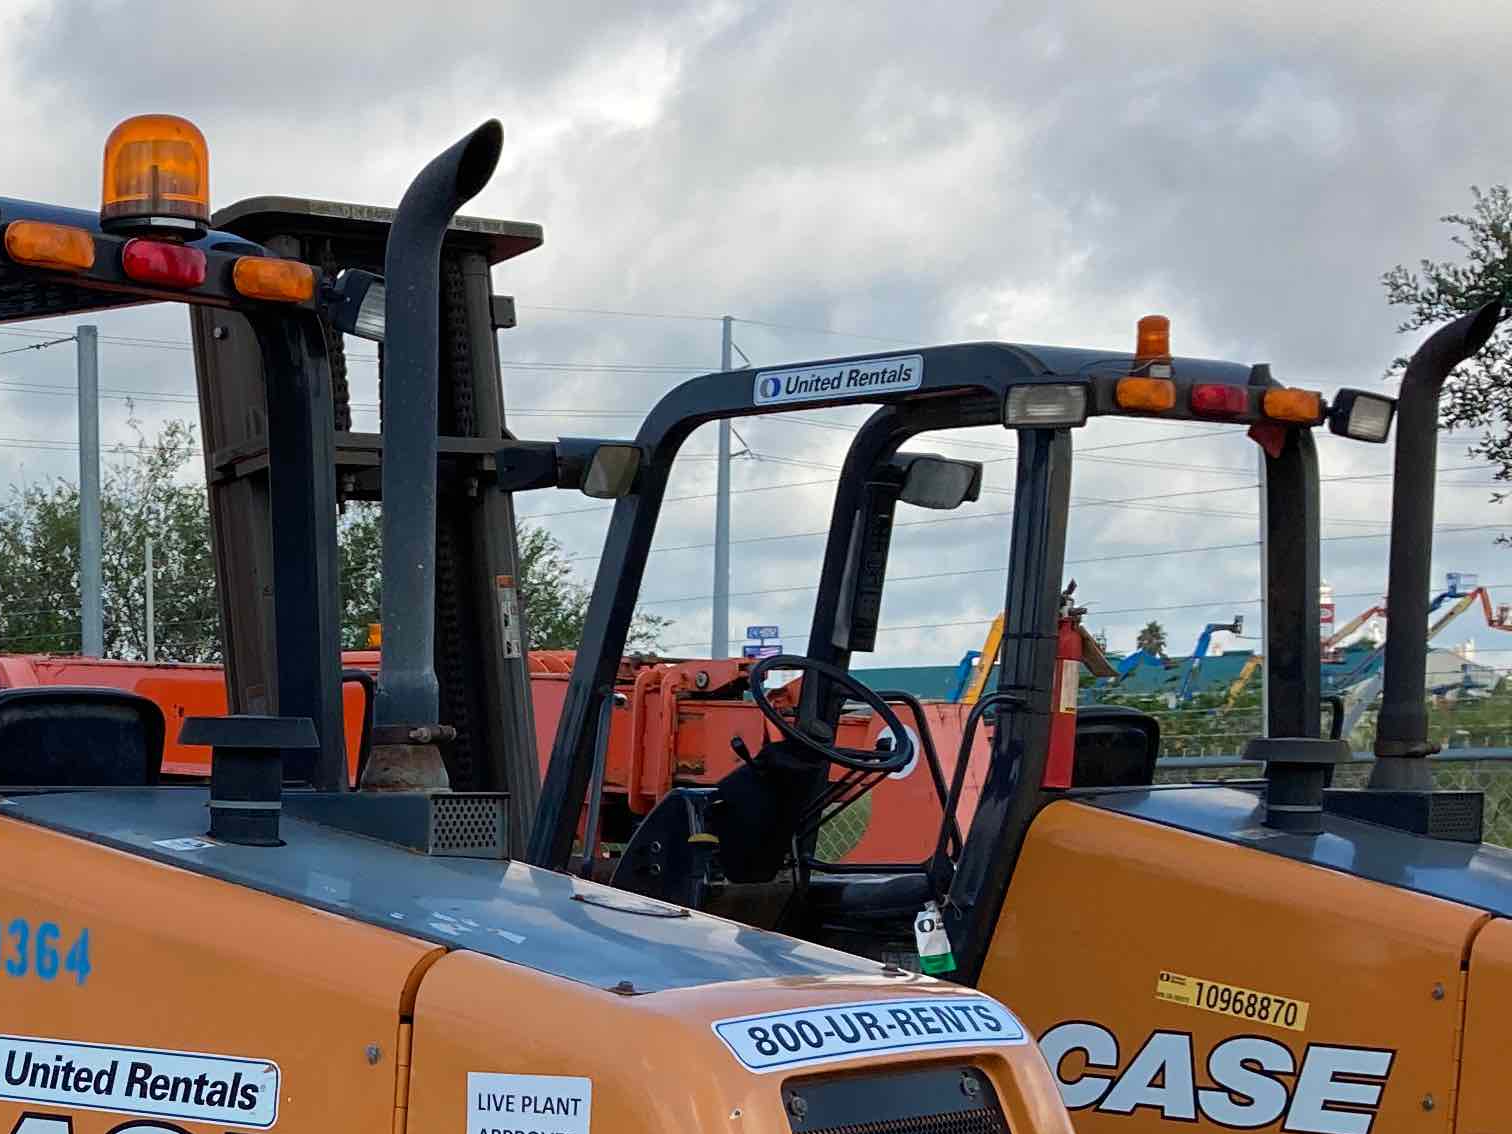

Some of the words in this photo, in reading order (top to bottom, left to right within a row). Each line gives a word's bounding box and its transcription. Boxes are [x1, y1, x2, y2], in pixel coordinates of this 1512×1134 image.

[785, 371, 843, 394] United
[846, 363, 913, 387] Rentals
[1196, 982, 1298, 1026] 10968870
[748, 1005, 1002, 1055] 800-UR-RENTS
[4, 1050, 119, 1095] United
[125, 1061, 259, 1110] Rentals
[478, 1092, 515, 1112] LIVE
[521, 1096, 582, 1116] PLANT
